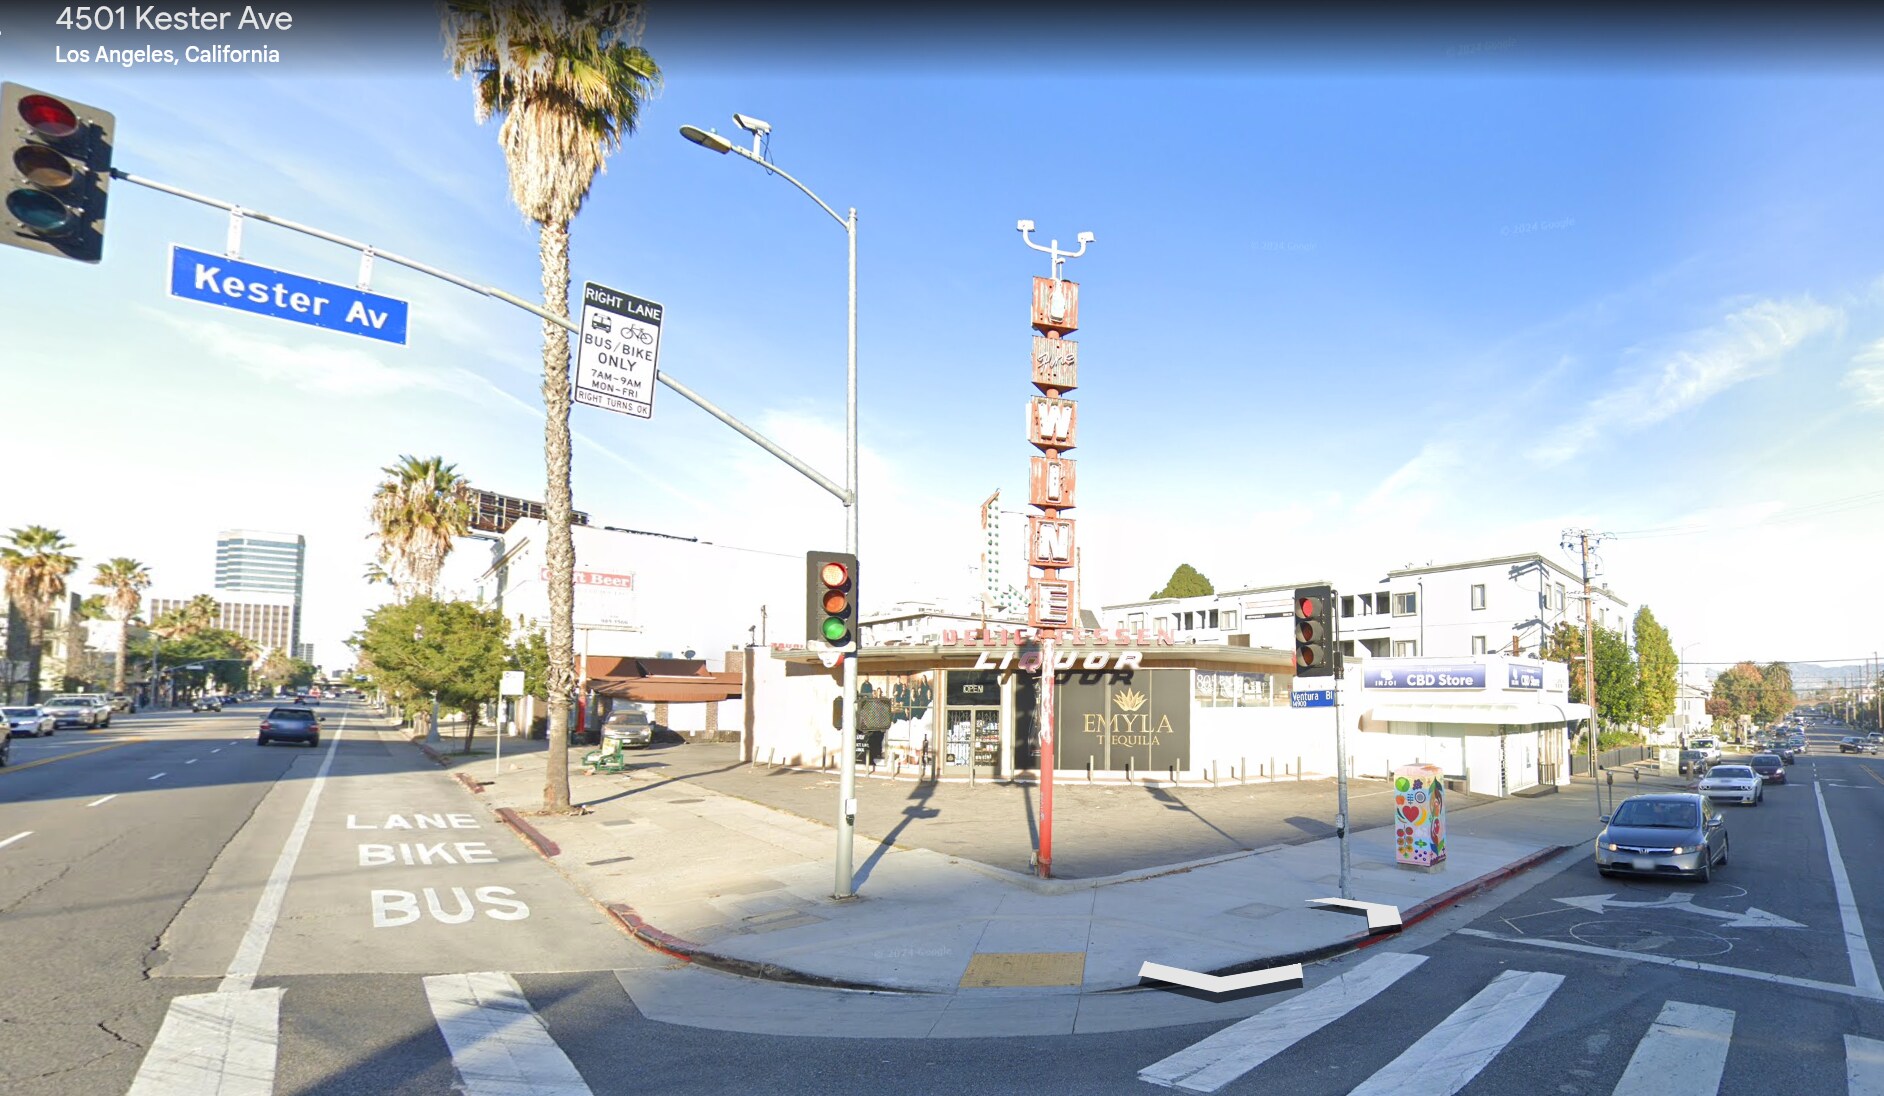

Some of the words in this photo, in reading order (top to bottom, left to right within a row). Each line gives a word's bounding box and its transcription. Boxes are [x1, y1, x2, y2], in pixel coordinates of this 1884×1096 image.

[195, 263, 330, 316] Kester
[345, 300, 389, 330] Av
[585, 287, 624, 308] RIGHT
[627, 301, 662, 321] LANE
[584, 333, 654, 361] BUS/BIKE
[598, 352, 637, 372] ONLY
[578, 390, 603, 404] RIGHT
[606, 397, 634, 411] TURNS
[636, 404, 649, 415] OK
[1037, 401, 1074, 624] WINE
[591, 574, 630, 587] Beer
[974, 650, 1144, 673] LIQUOR
[964, 685, 984, 693] OPEN
[1406, 673, 1436, 686] CBD
[1438, 673, 1474, 686] Store
[1292, 692, 1319, 702] Ventura
[1325, 690, 1333, 700] Bl
[1082, 713, 1174, 733] EMYLA
[1096, 735, 1160, 747] TEQUILA
[346, 814, 481, 829] LANE
[358, 842, 500, 866] BIKE
[371, 886, 530, 928] BUS
